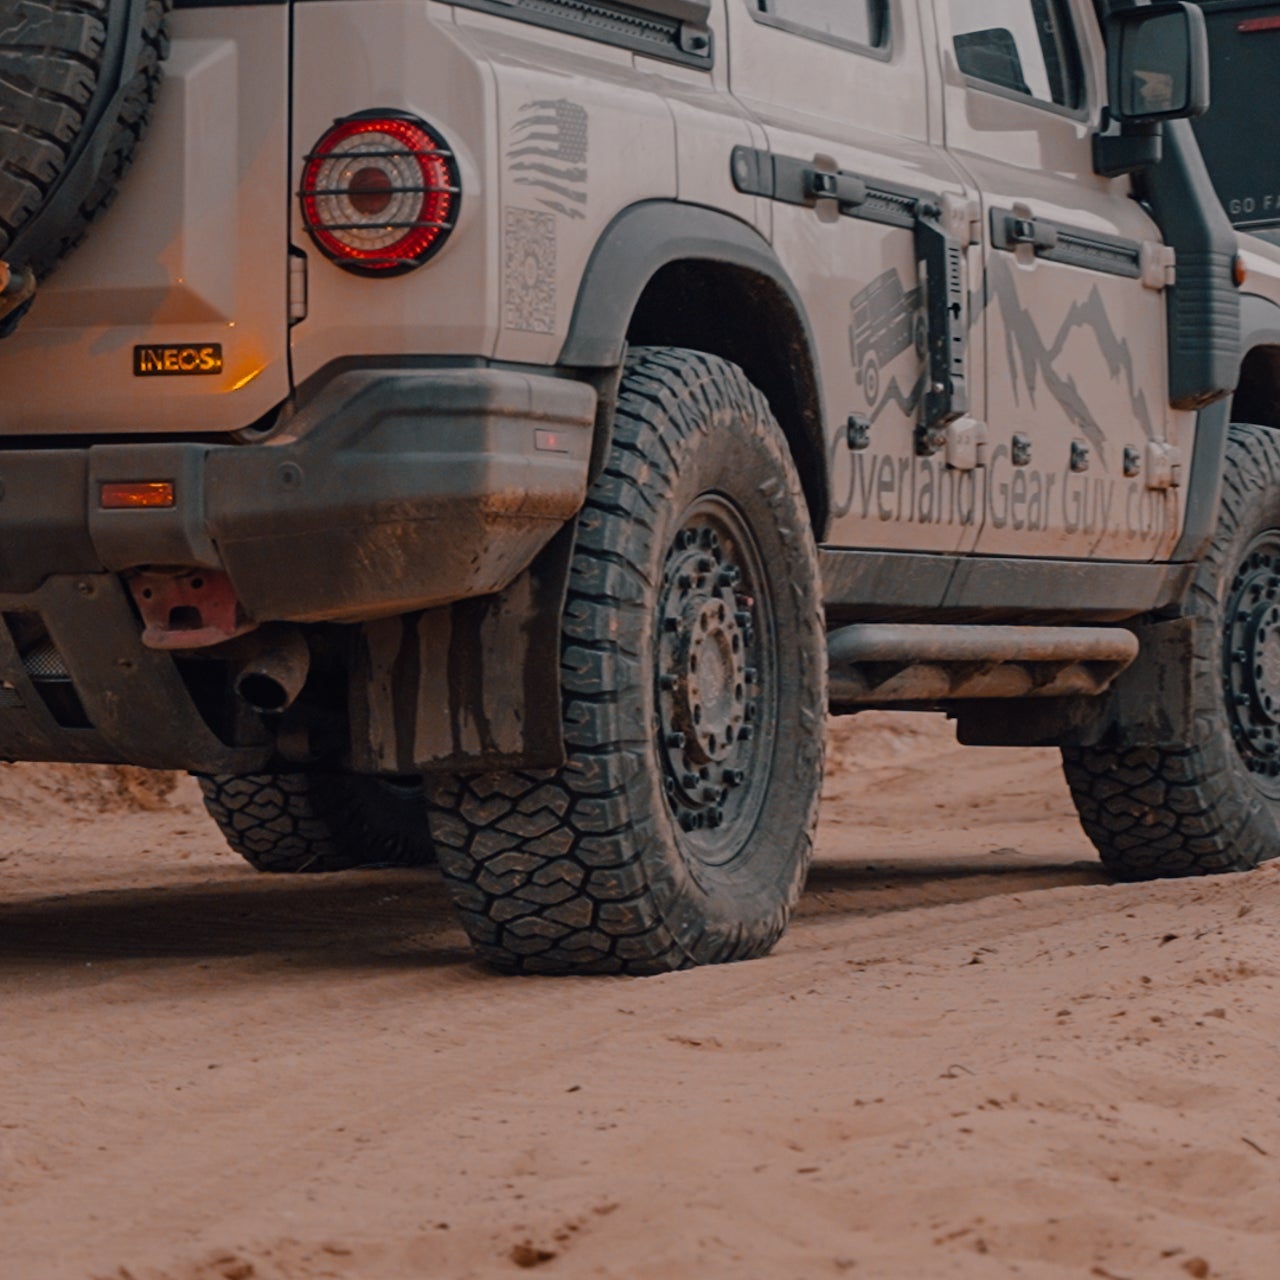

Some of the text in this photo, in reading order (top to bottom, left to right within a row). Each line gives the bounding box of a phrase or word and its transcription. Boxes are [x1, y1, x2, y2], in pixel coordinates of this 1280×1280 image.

[1228, 197, 1256, 214] GO
[140, 347, 215, 371] INEOS
[989, 443, 1056, 532] Gear
